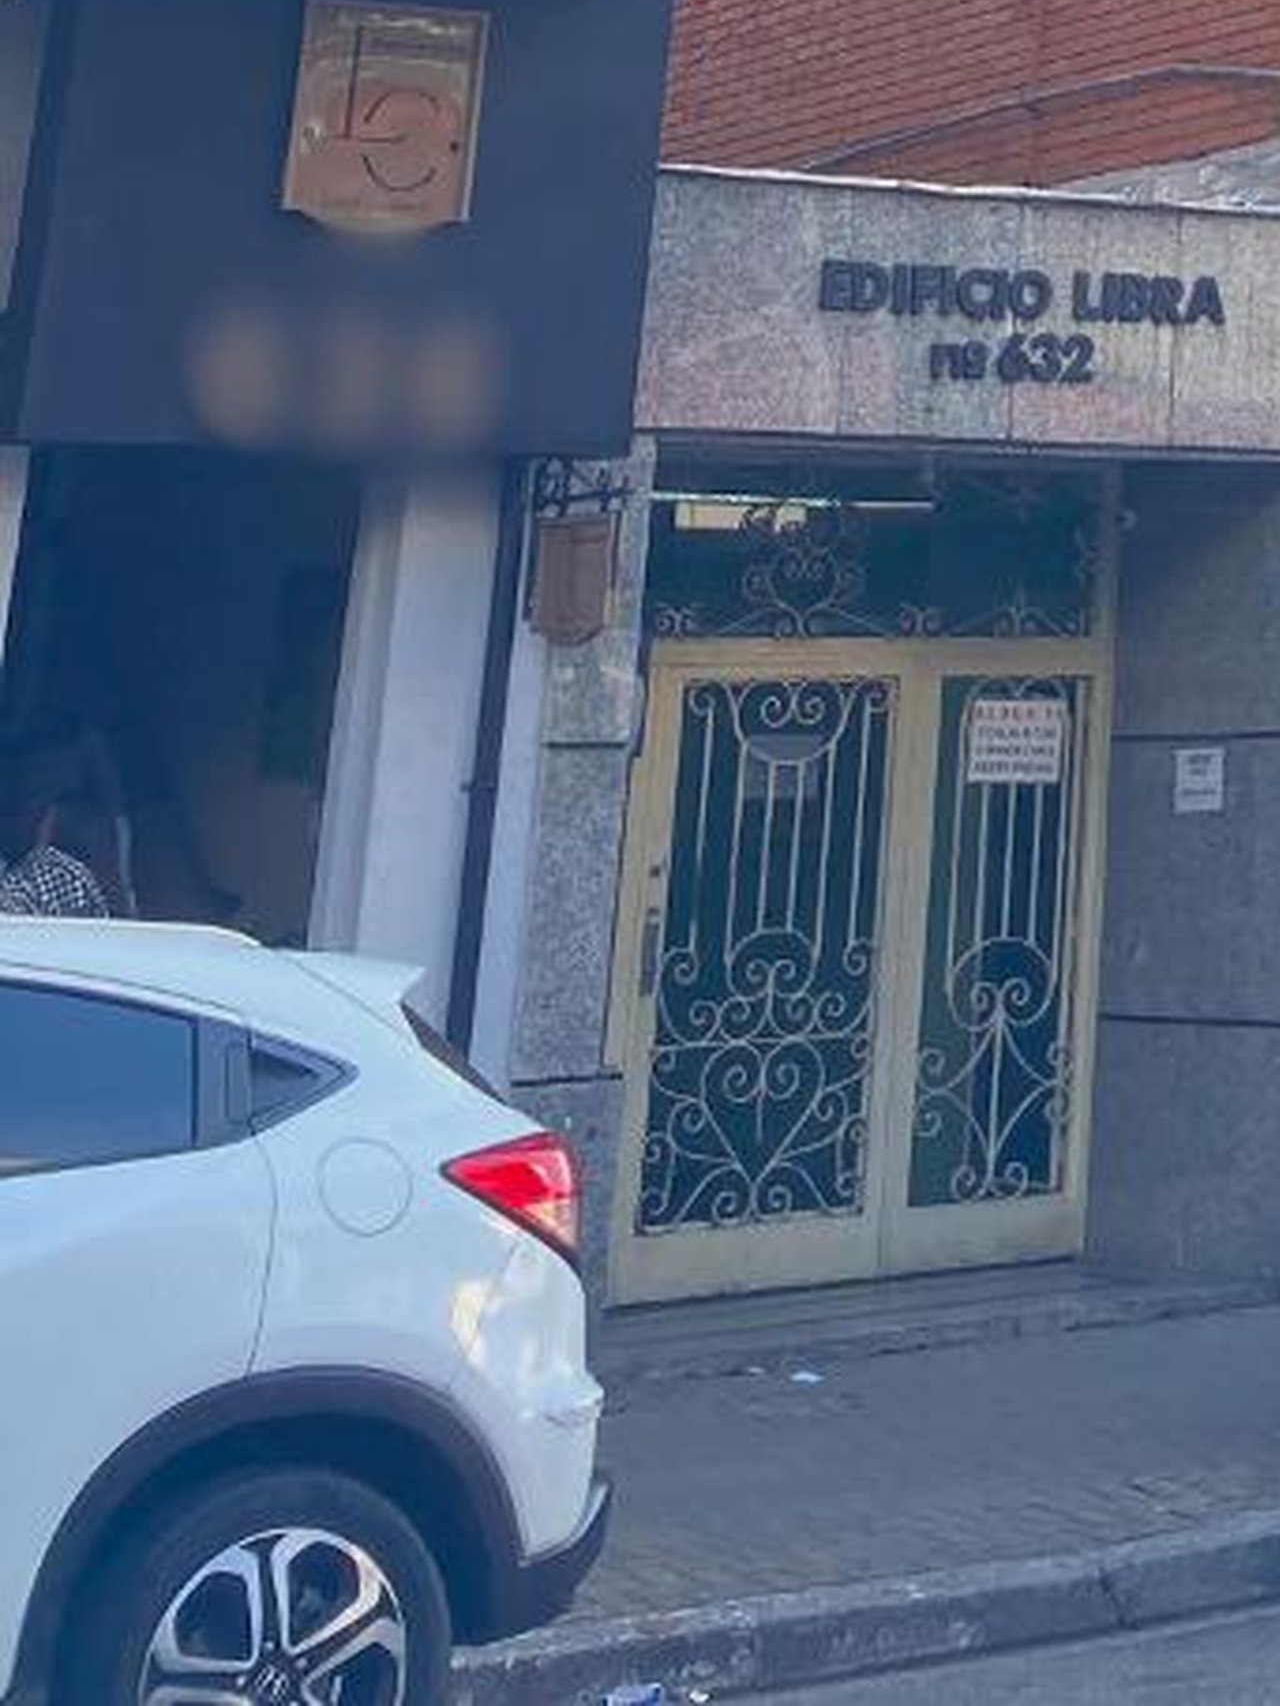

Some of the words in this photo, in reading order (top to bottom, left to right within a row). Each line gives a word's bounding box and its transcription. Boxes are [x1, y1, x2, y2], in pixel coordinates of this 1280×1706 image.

[818, 258, 1054, 322] EDIFICIO
[1072, 270, 1227, 326] LIBRA
[996, 333, 1095, 384] 632
